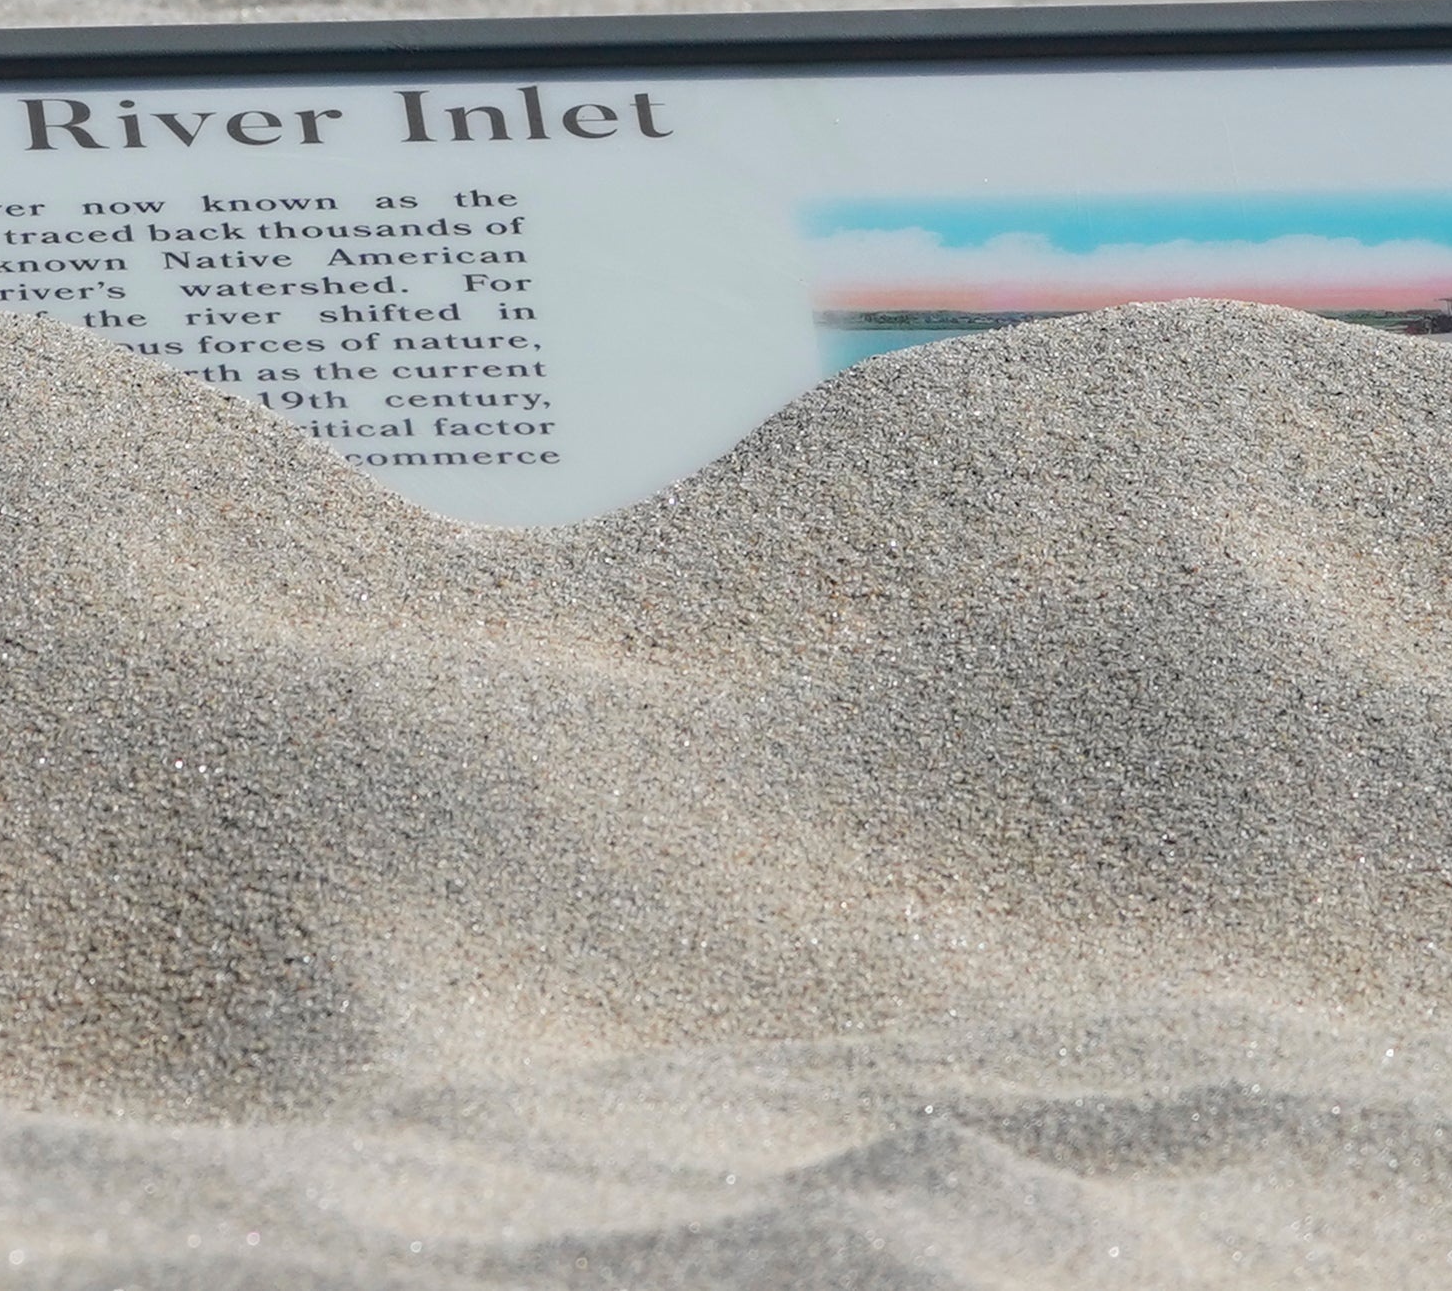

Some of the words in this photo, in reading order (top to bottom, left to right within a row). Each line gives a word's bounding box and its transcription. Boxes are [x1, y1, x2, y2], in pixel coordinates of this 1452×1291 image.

[16, 97, 343, 151] River
[397, 84, 675, 143] Inlet
[81, 200, 166, 216] now
[201, 194, 339, 213] known
[375, 195, 419, 210] as
[454, 189, 519, 209] the
[3, 224, 135, 246] traced
[147, 221, 246, 243] back
[256, 217, 473, 240] thousands
[485, 216, 526, 236] of
[161, 250, 293, 270] Native
[326, 246, 529, 267] American
[179, 275, 410, 298] watershed.
[462, 273, 533, 293] For
[82, 310, 148, 329] the
[185, 308, 282, 325] river
[318, 302, 462, 324] shifted
[498, 302, 537, 320] in
[197, 335, 326, 354] forces
[340, 331, 381, 353] of
[393, 331, 543, 353] nature,
[256, 367, 301, 382] as
[313, 362, 379, 381] the
[392, 360, 548, 380] current
[257, 390, 349, 411] 19th
[385, 389, 553, 412] century,
[432, 418, 557, 438] factor
[344, 448, 562, 467] commerce
